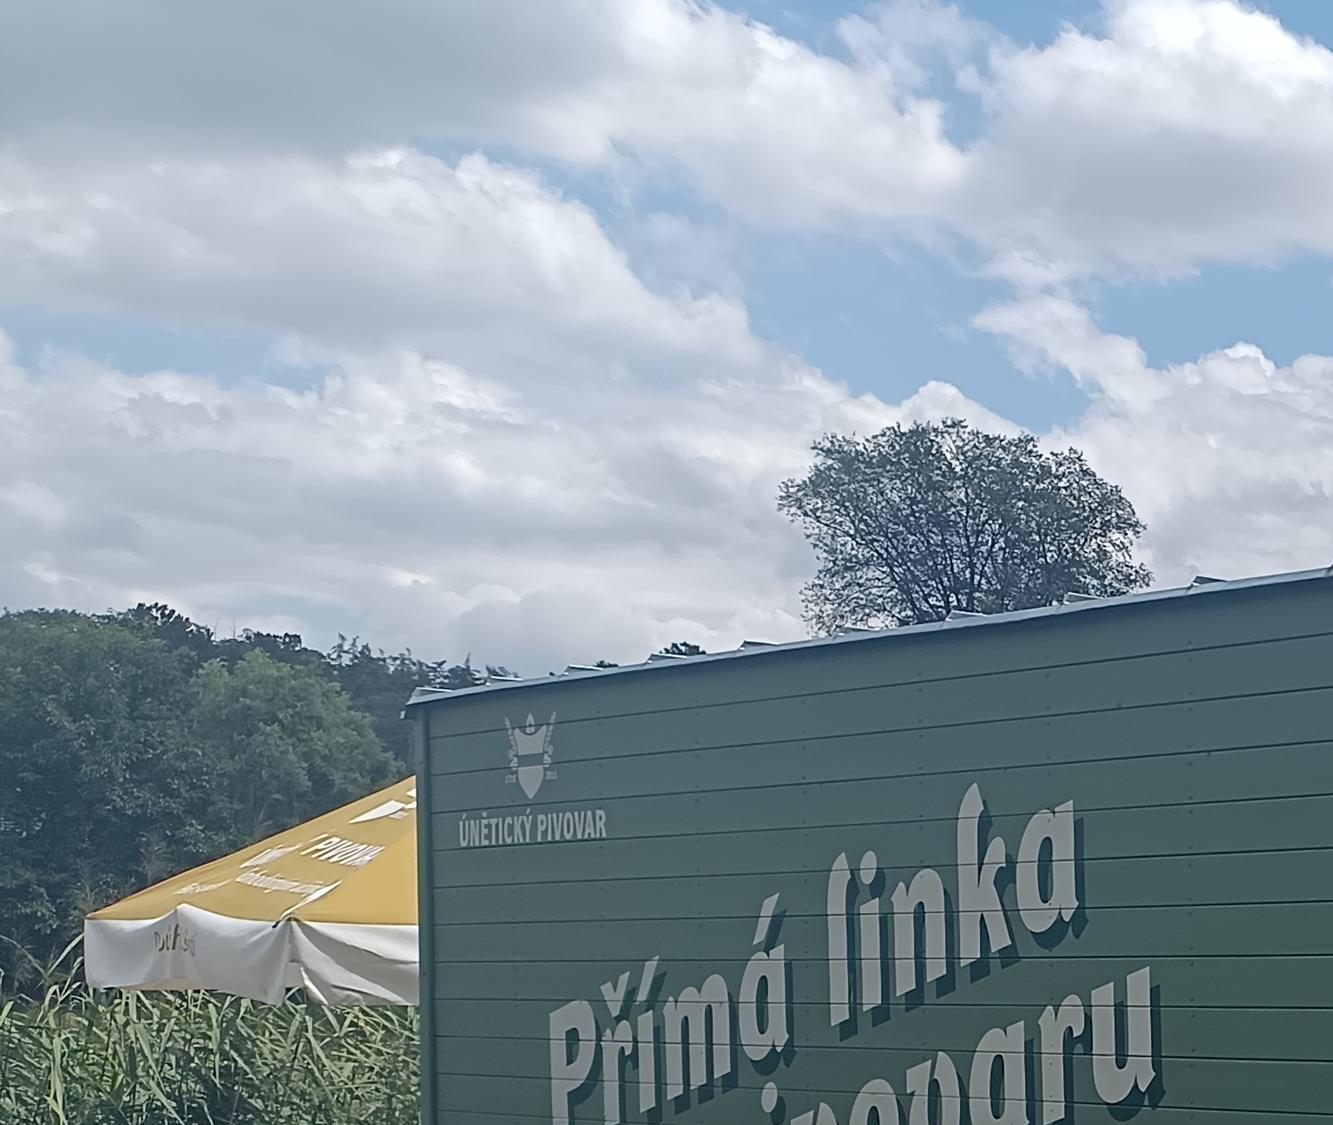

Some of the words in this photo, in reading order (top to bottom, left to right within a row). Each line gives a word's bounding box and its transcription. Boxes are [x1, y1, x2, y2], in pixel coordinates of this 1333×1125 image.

[459, 808, 533, 848] ÚNĚTICKÝ
[537, 809, 607, 842] PIVOVAR
[826, 782, 1079, 1028] linka
